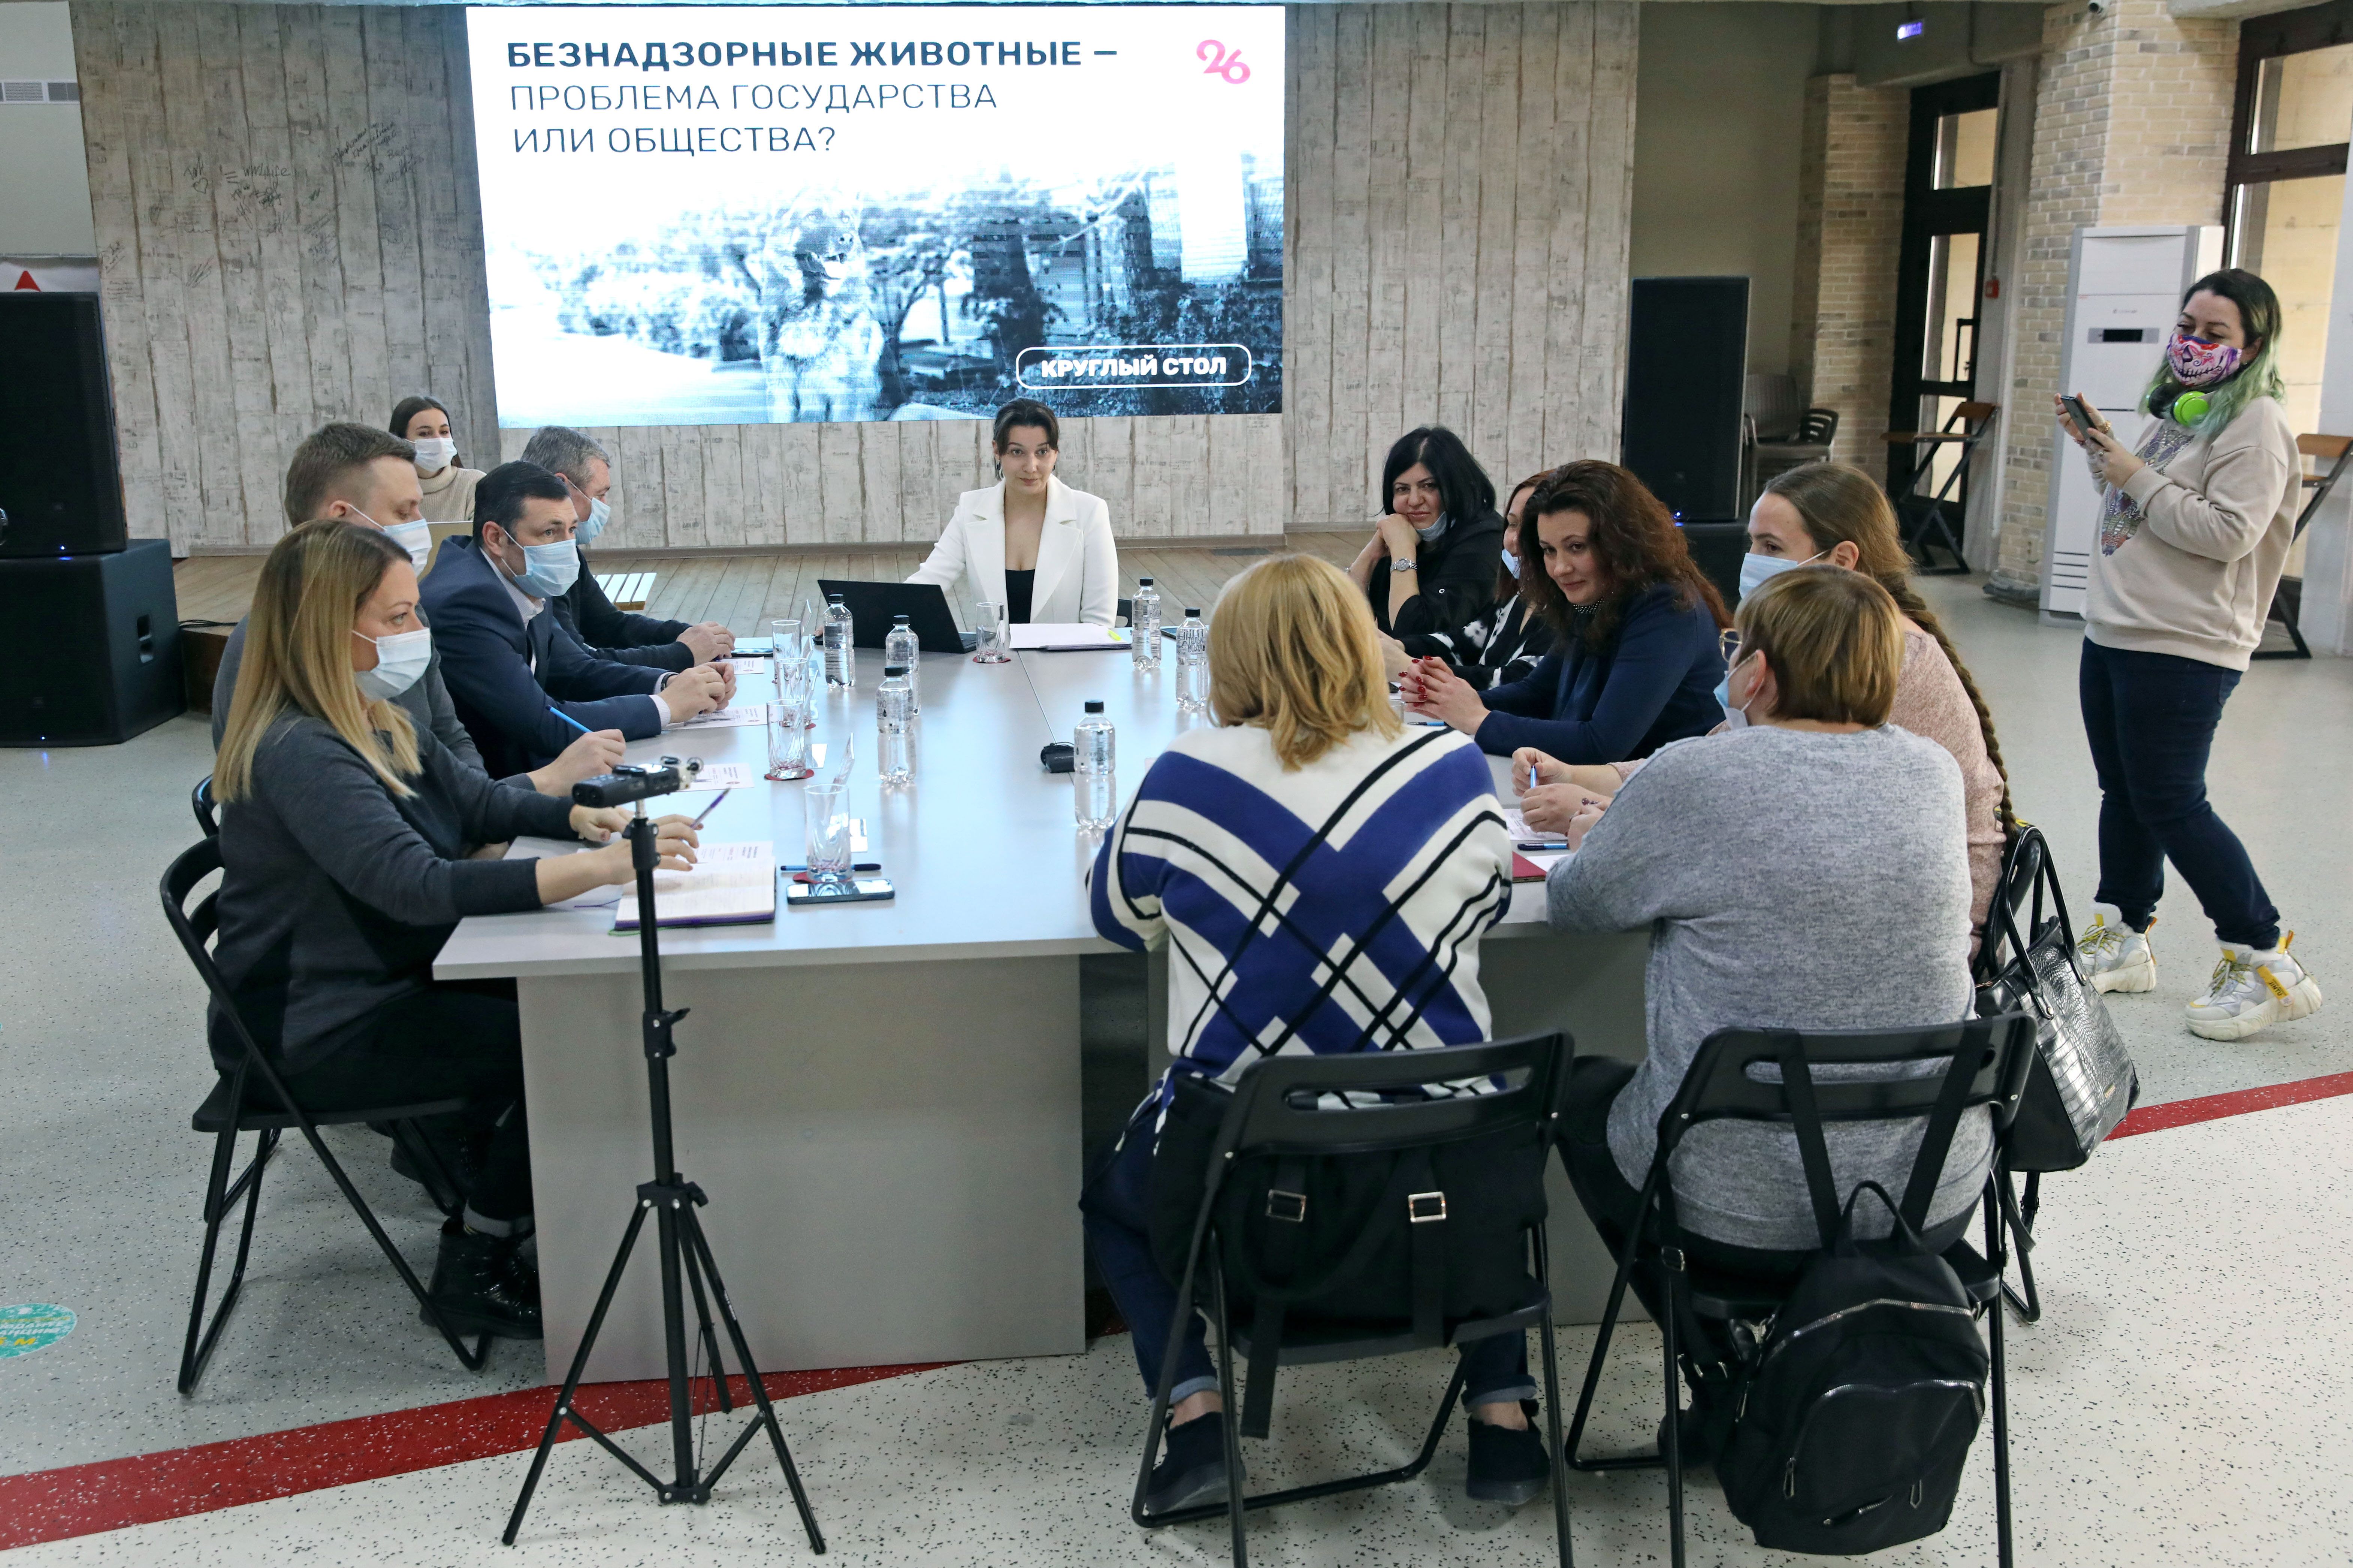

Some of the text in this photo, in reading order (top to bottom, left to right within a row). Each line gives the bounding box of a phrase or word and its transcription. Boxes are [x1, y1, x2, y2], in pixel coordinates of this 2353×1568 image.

[507, 41, 838, 72] БЕЗНАДЗОРНЫЕ
[850, 41, 1081, 66] ЖИВОТНЫЕ
[1196, 39, 1250, 84] 26
[511, 83, 997, 114] ПРОБЛЕМА ГОСУДАРСТВА
[514, 126, 836, 157] ИЛИ ОБЩЕСТВА?
[1041, 354, 1227, 377] КРУГЛЫЙ СТОЛ
[1188, 644, 1202, 653] ВОДА
